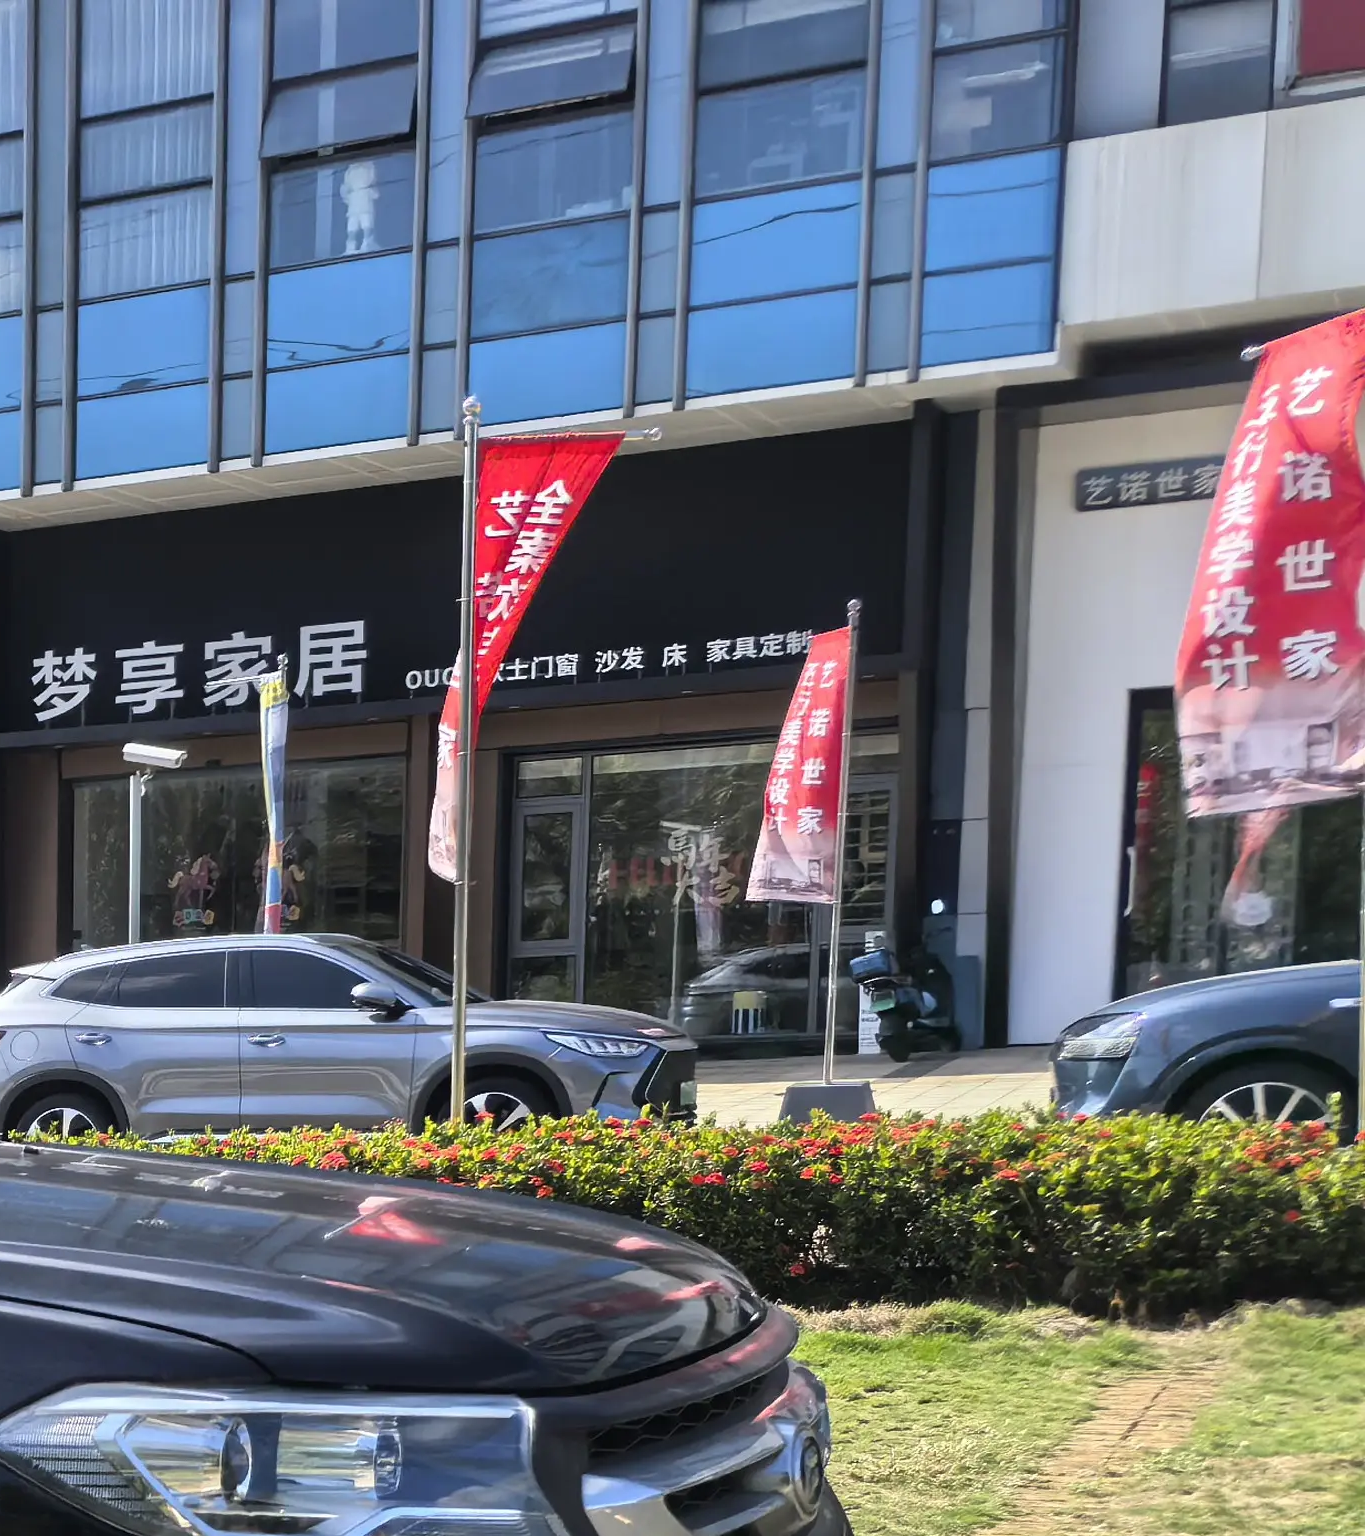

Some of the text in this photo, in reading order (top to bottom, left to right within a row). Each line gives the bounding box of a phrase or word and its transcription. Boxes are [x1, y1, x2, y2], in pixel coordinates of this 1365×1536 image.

[1199, 383, 1279, 692] 五行美学设计
[1275, 365, 1339, 682] 艺诺世家
[31, 620, 368, 723] 梦享家居
[595, 646, 645, 674] 沙发
[662, 643, 688, 668] 床
[706, 629, 815, 664] 家具定制
[797, 659, 838, 836] 艺诺世家
